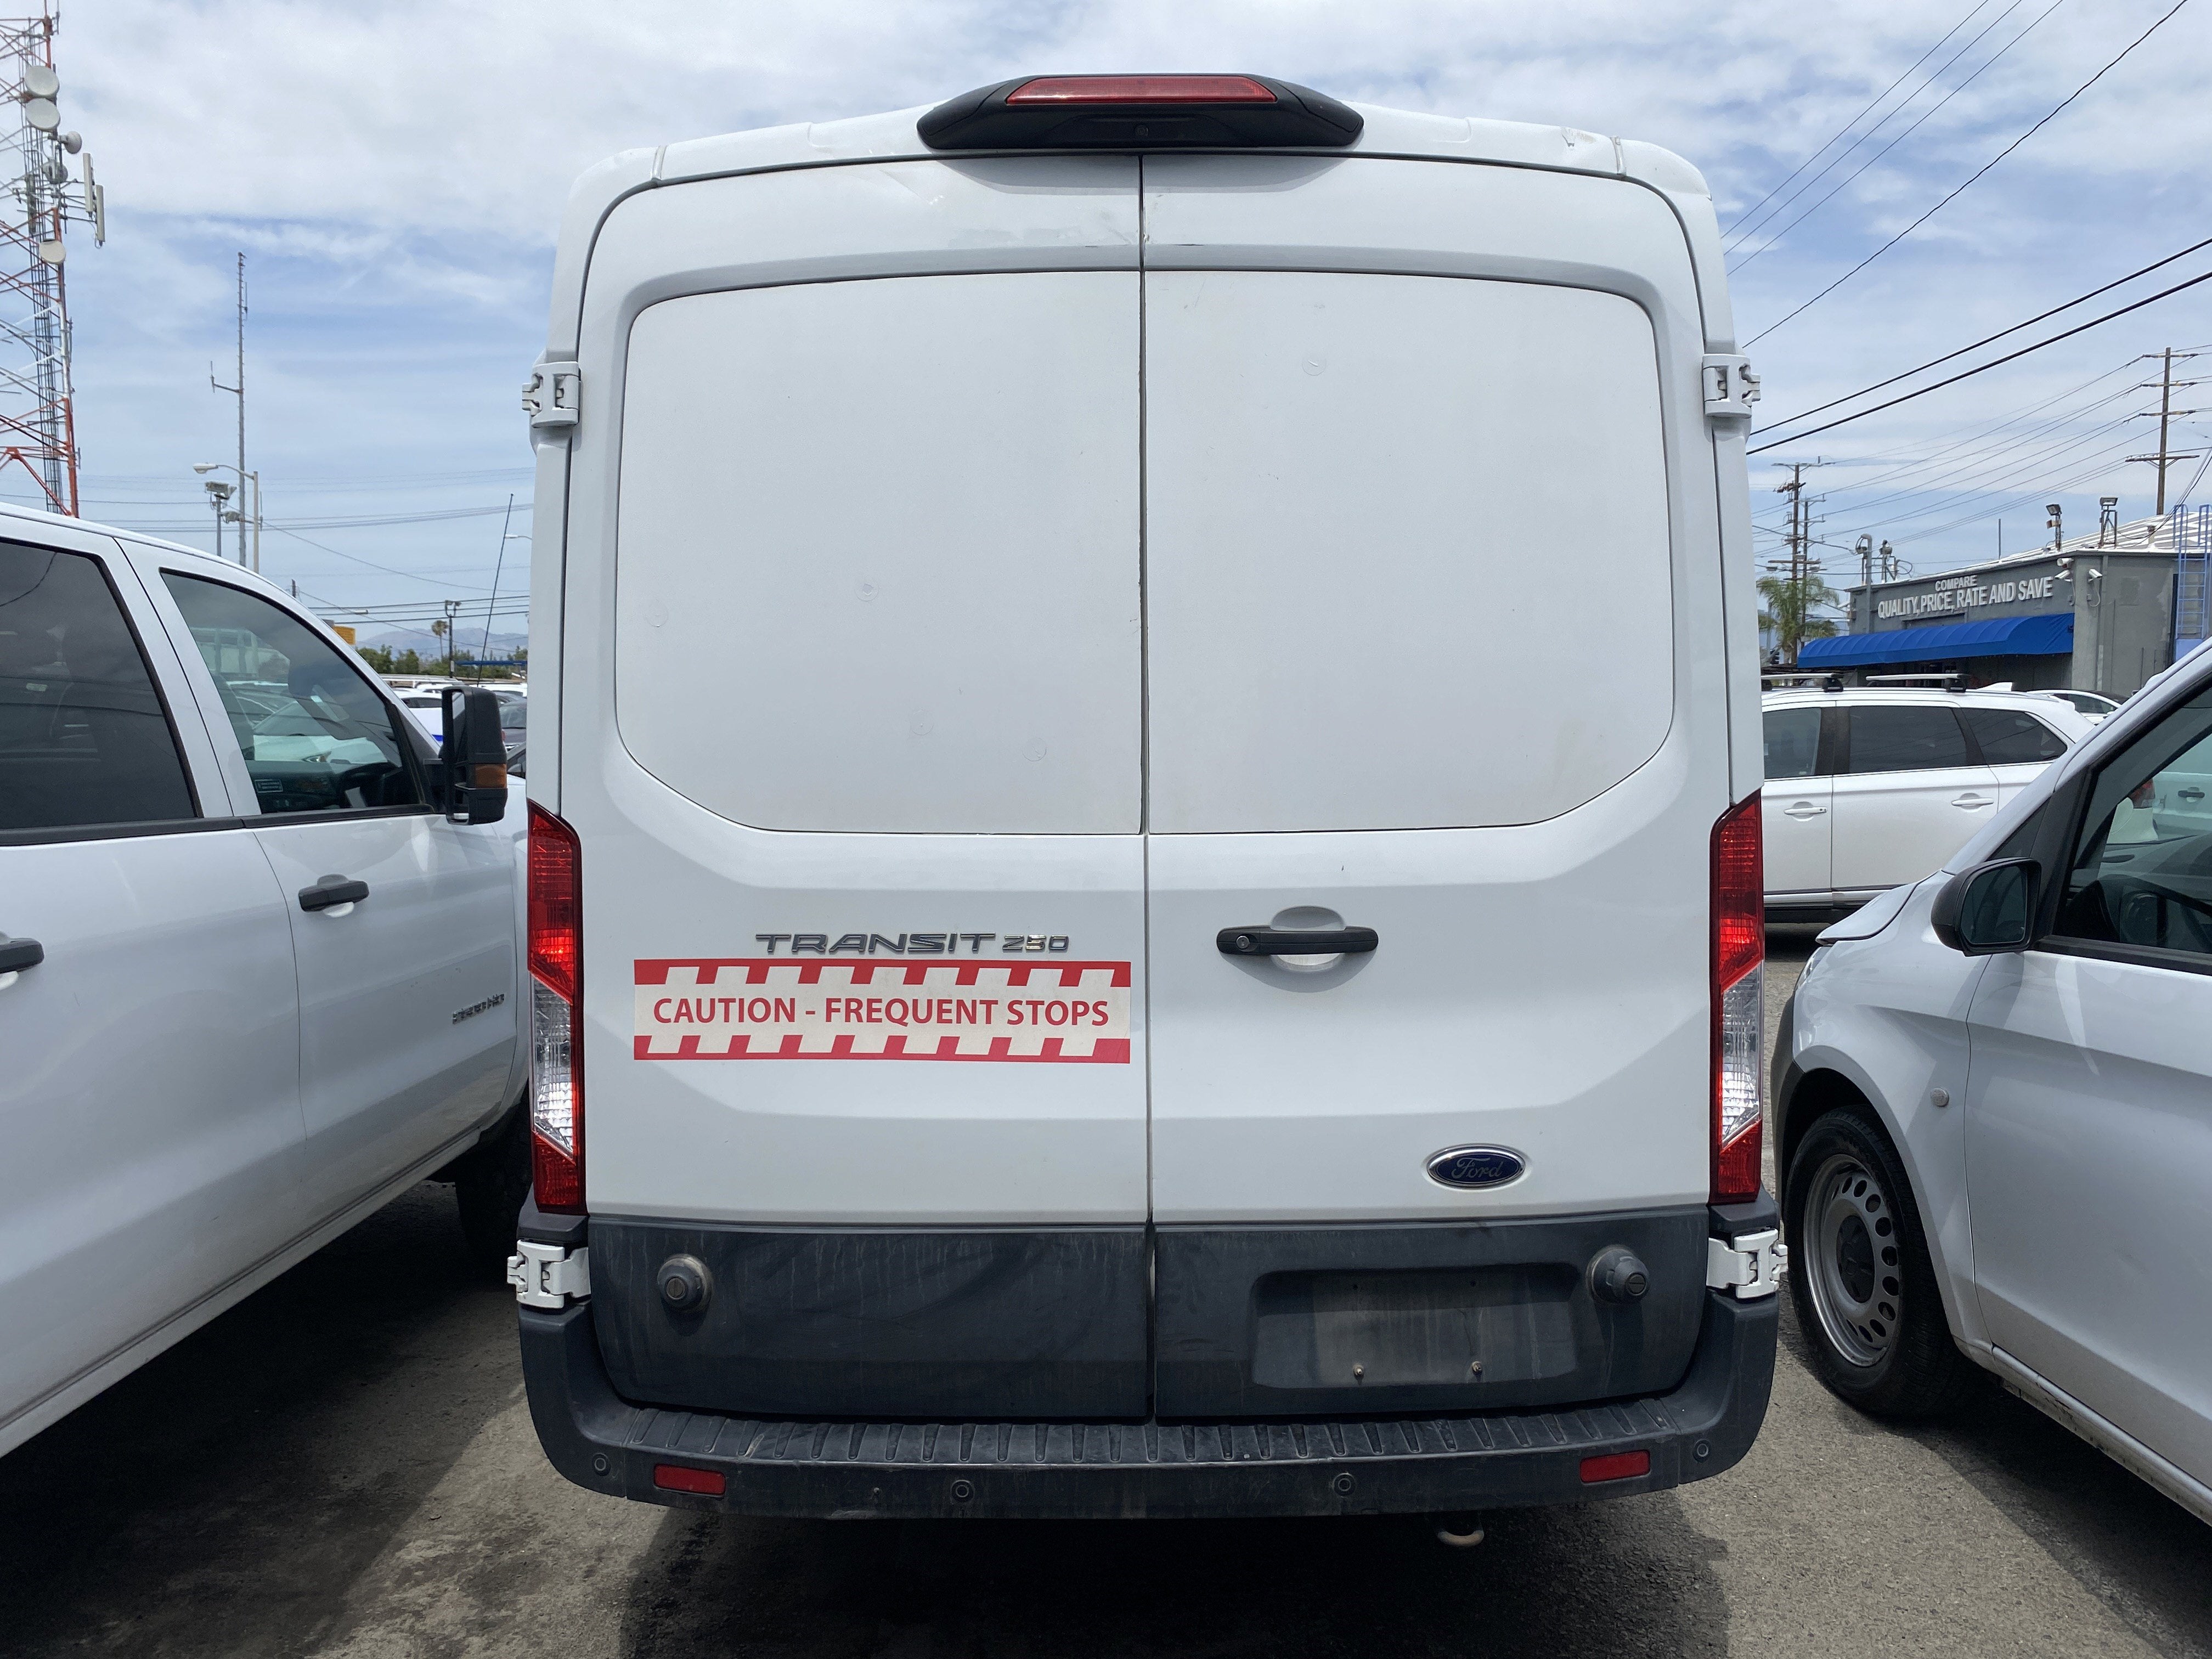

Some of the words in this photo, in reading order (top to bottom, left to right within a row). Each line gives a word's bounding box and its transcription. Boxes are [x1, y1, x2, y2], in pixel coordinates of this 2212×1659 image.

[1935, 575, 1978, 591] COMPARE
[1878, 596, 1920, 619] QUALITY,
[1921, 591, 1955, 612] PRICE,
[1957, 586, 1988, 608] RATE
[1989, 582, 2016, 604] AND
[2018, 576, 2054, 601] SAVE
[755, 932, 996, 953] TRANSIT
[1002, 934, 1070, 951] 250
[653, 997, 795, 1024] CAUTION
[825, 997, 998, 1026] FREQUENT
[1007, 1000, 1109, 1026] STOPS
[1451, 1156, 1504, 1179] Ford
